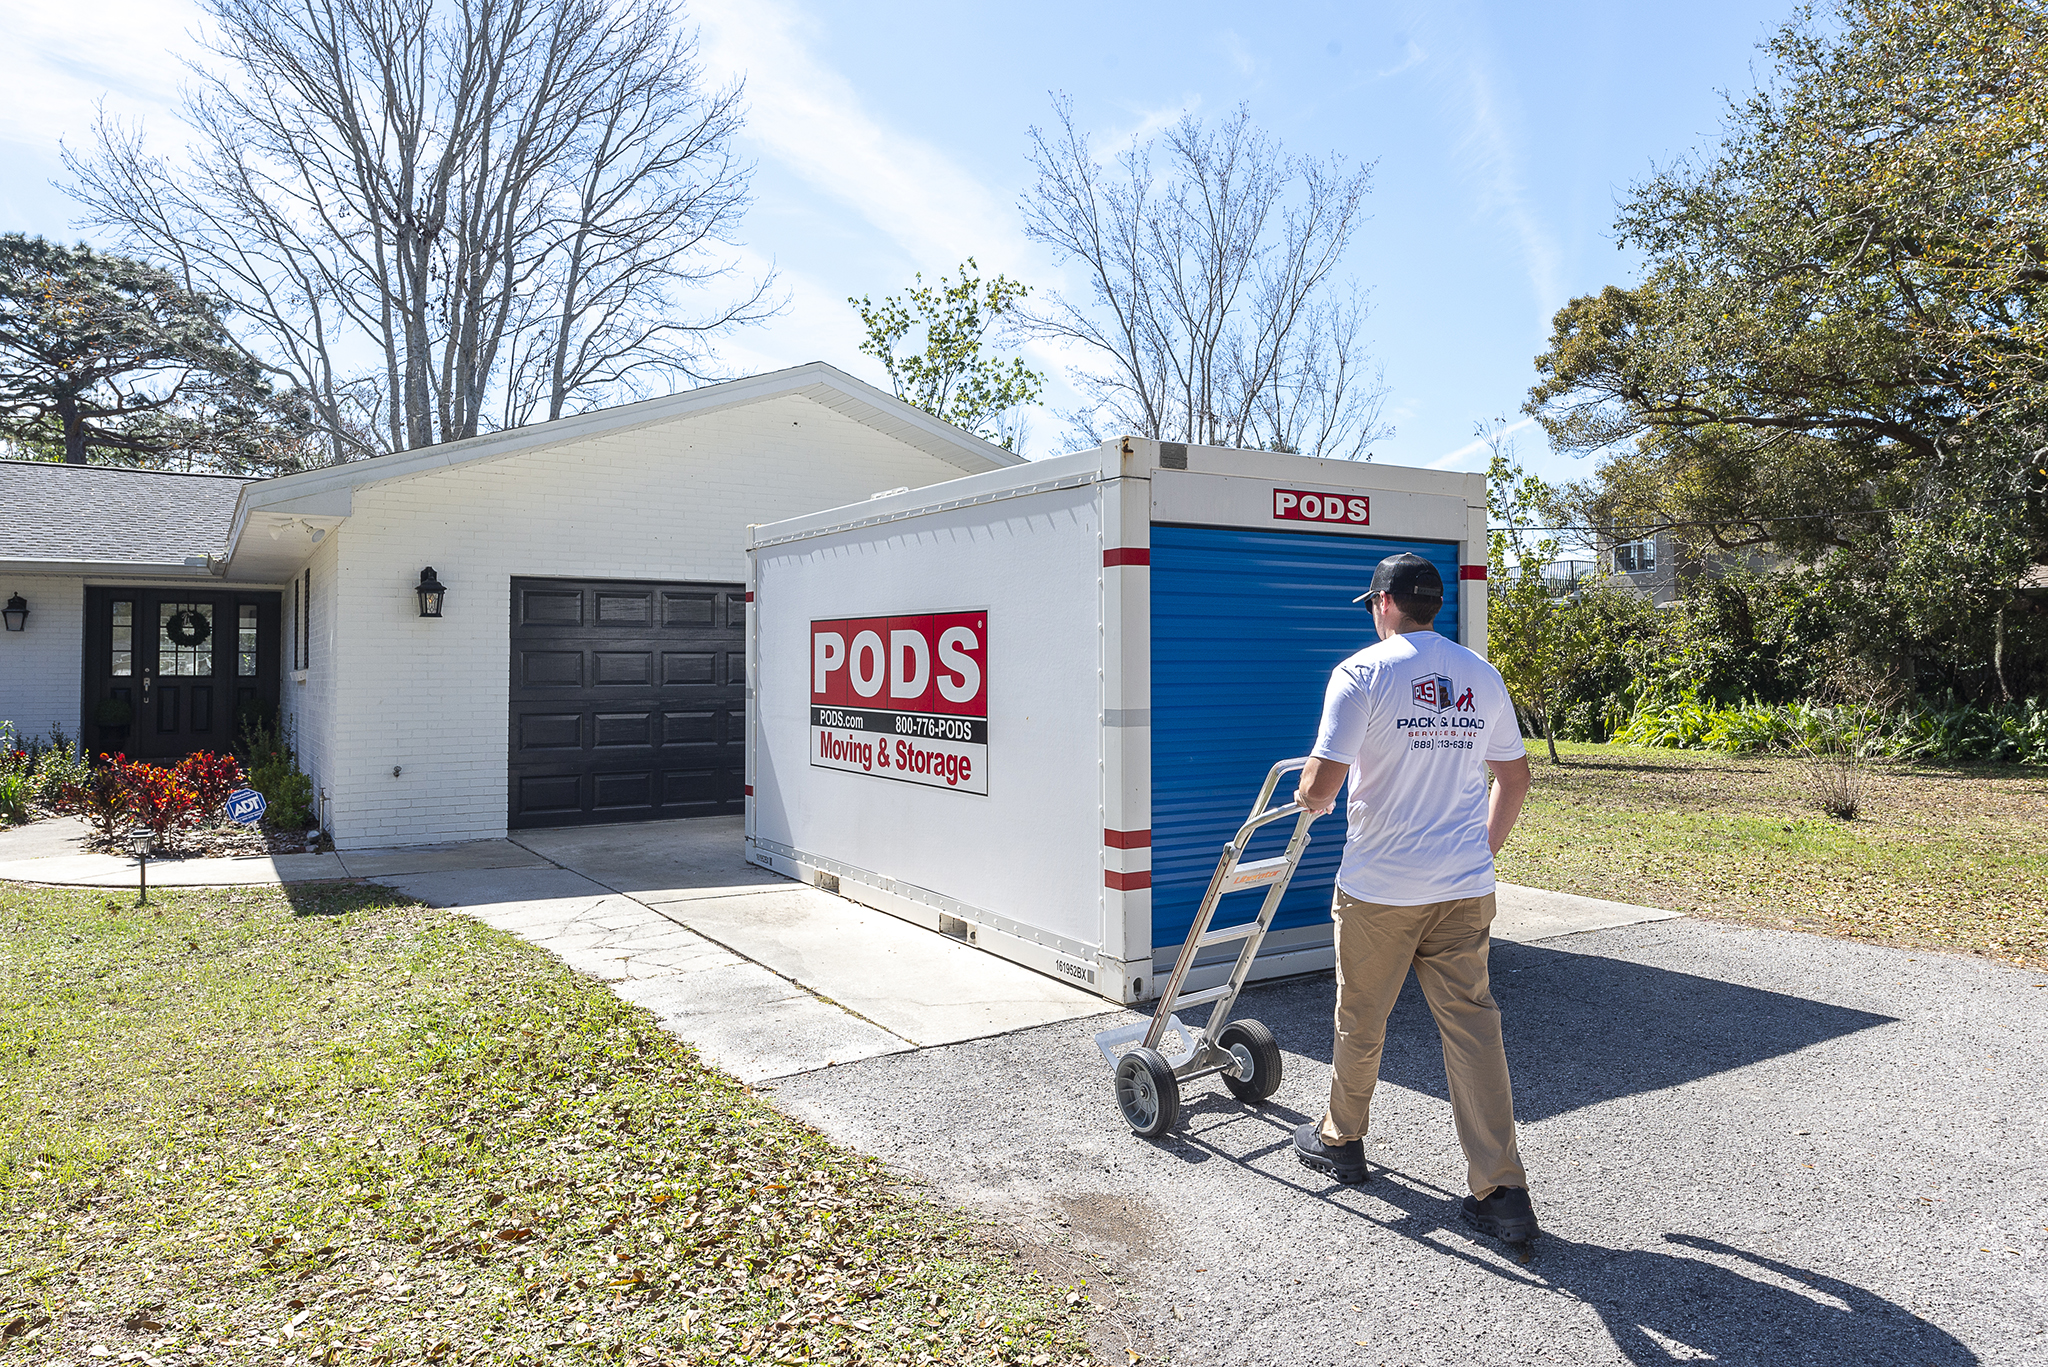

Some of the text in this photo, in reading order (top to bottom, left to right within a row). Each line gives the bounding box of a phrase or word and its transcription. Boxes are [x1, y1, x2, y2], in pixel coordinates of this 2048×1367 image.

[1275, 492, 1368, 522] PODS
[814, 625, 981, 704] PODS
[1415, 682, 1435, 702] PLS
[819, 709, 972, 741] PODS.com 800-776-PODS
[1396, 716, 1485, 730] PACK & LOAD
[820, 730, 972, 786] Moving & Storage
[235, 795, 260, 817] ADT
[1055, 959, 1087, 981] 161952BX
